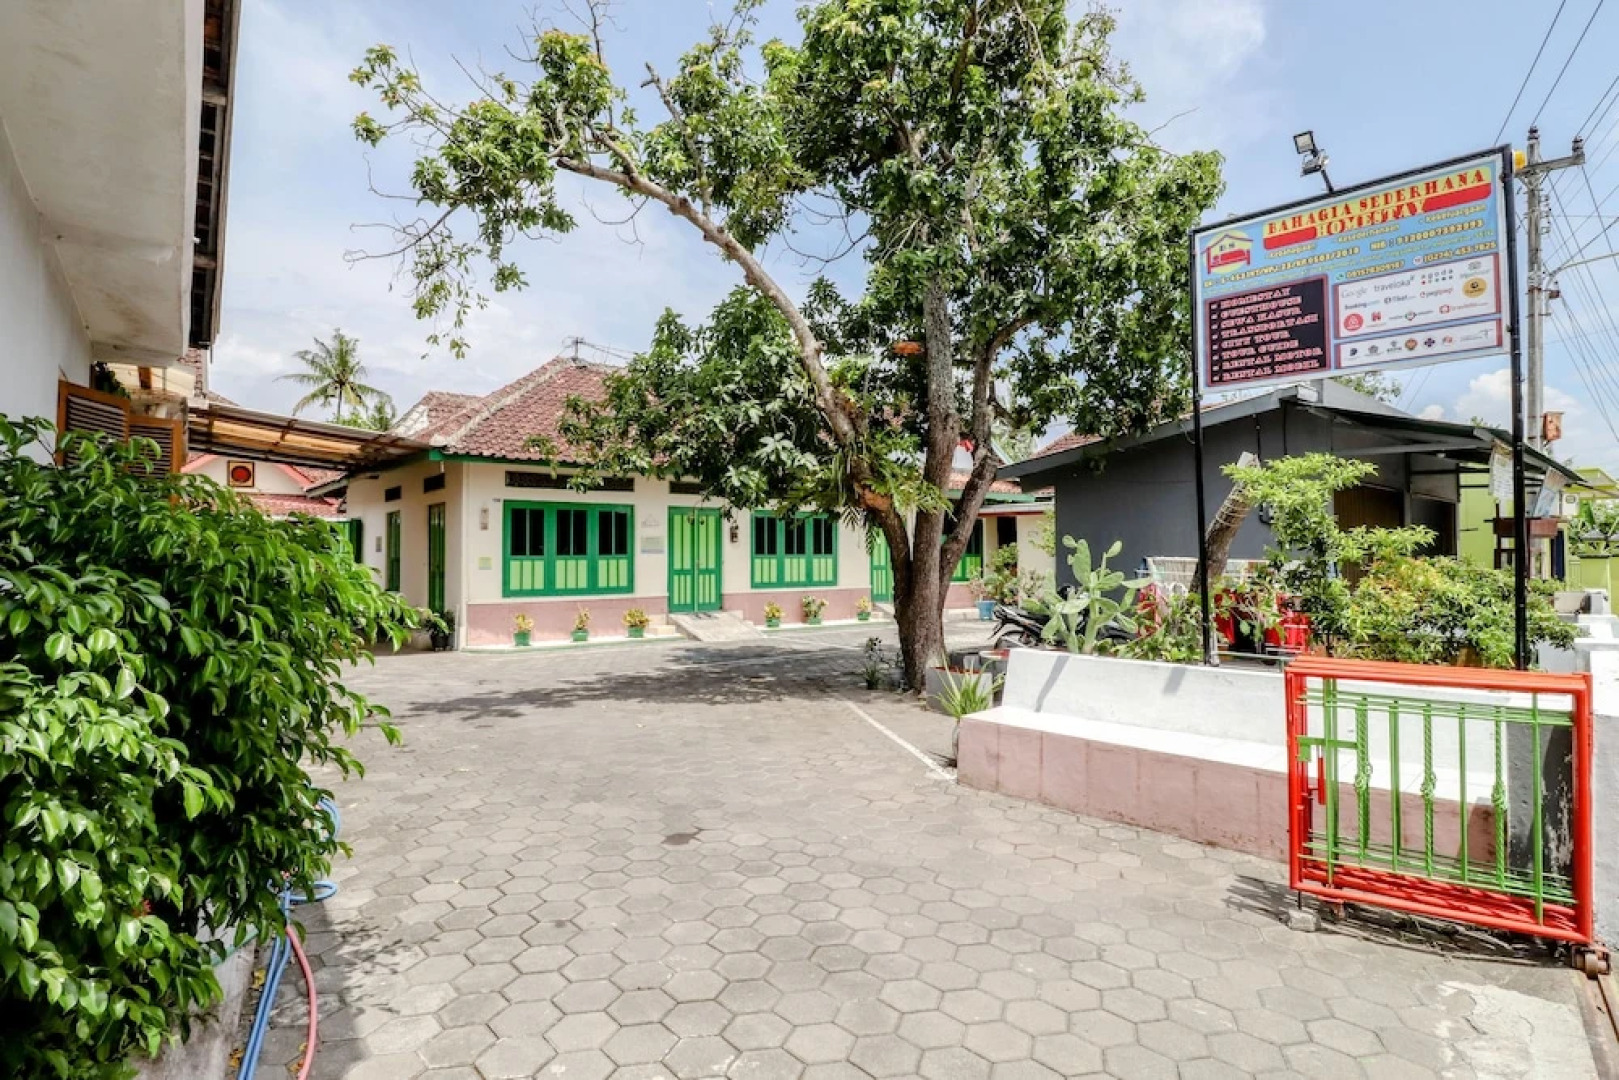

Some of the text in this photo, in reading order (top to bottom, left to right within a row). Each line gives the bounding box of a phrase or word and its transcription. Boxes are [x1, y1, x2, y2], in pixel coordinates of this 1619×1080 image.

[1268, 169, 1485, 234] BAHAGIA SEDERHANA
[1318, 198, 1423, 238] HOMESTAY
[1220, 287, 1291, 309] HOMESTAY
